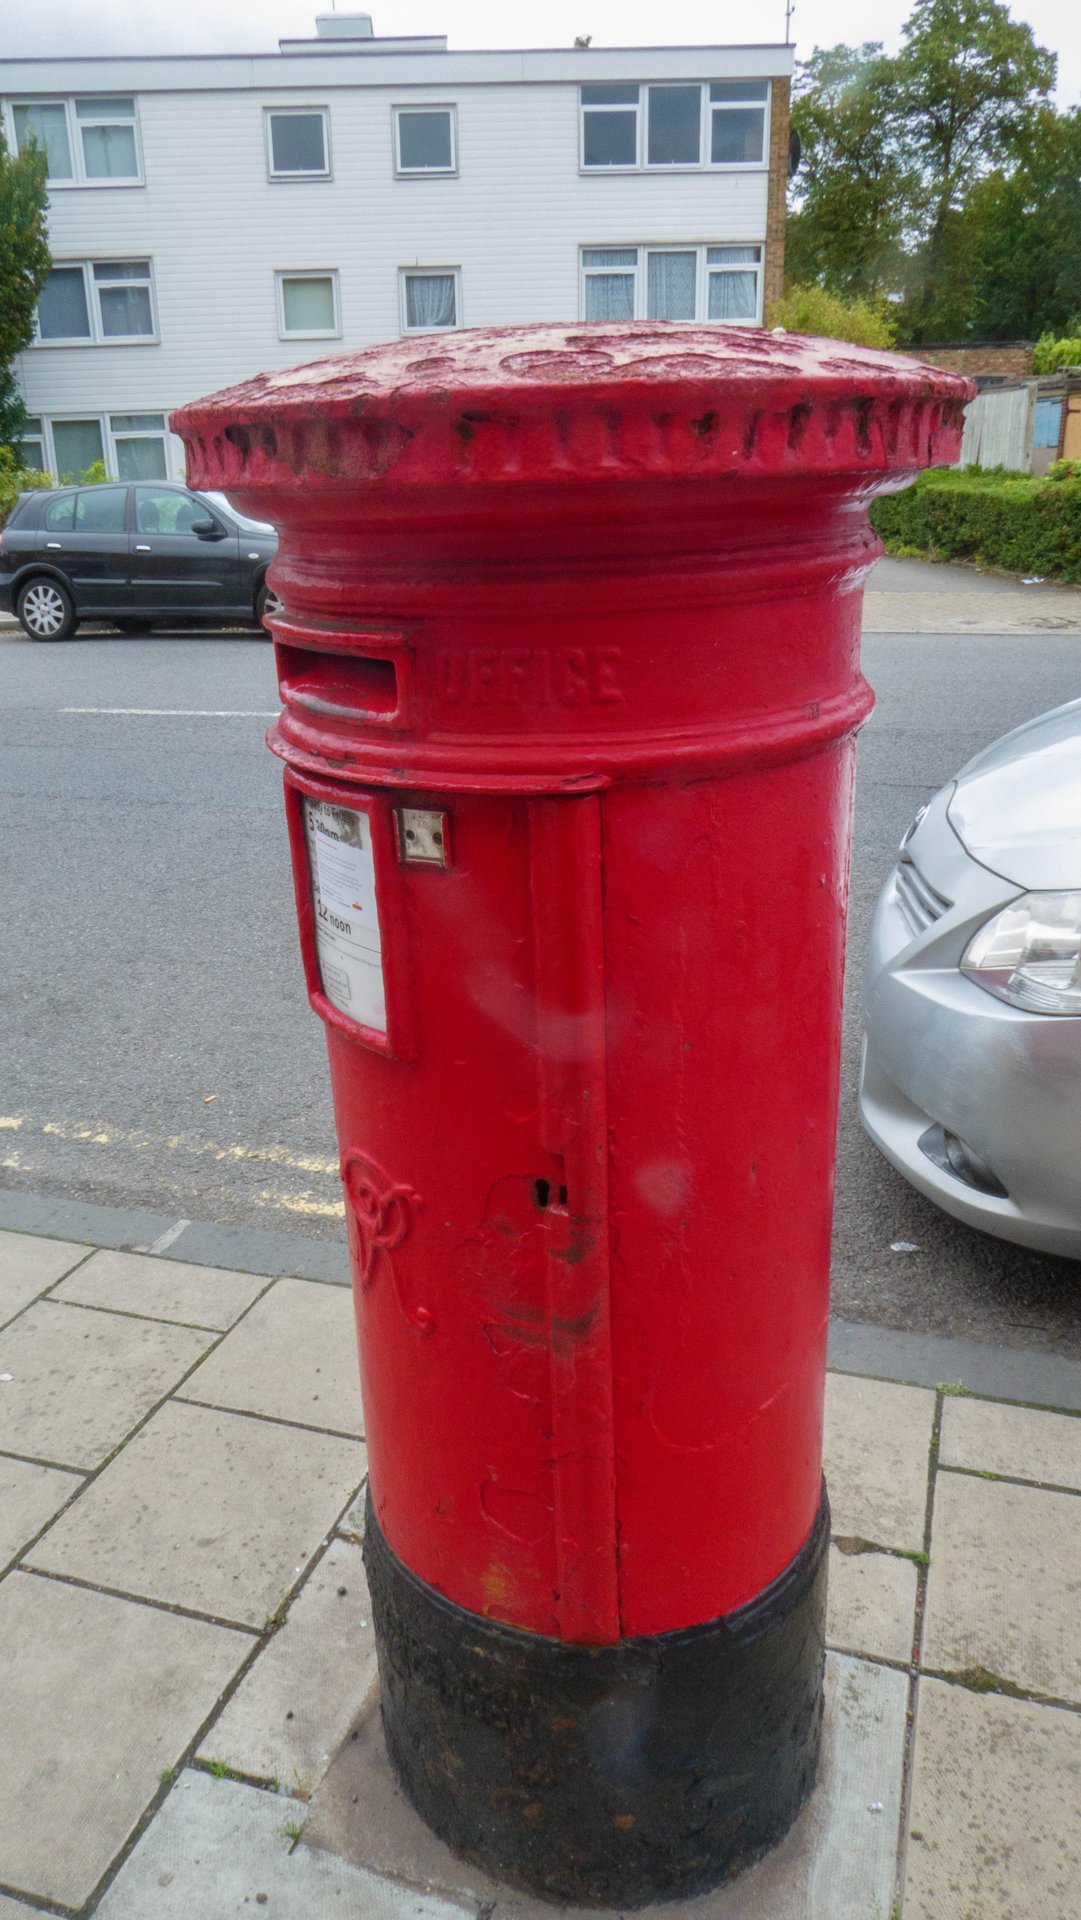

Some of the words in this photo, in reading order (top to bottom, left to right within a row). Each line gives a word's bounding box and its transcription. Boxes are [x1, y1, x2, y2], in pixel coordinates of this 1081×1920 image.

[436, 645, 626, 705] OFFICE
[318, 899, 328, 922] 12
[329, 915, 351, 935] noon
